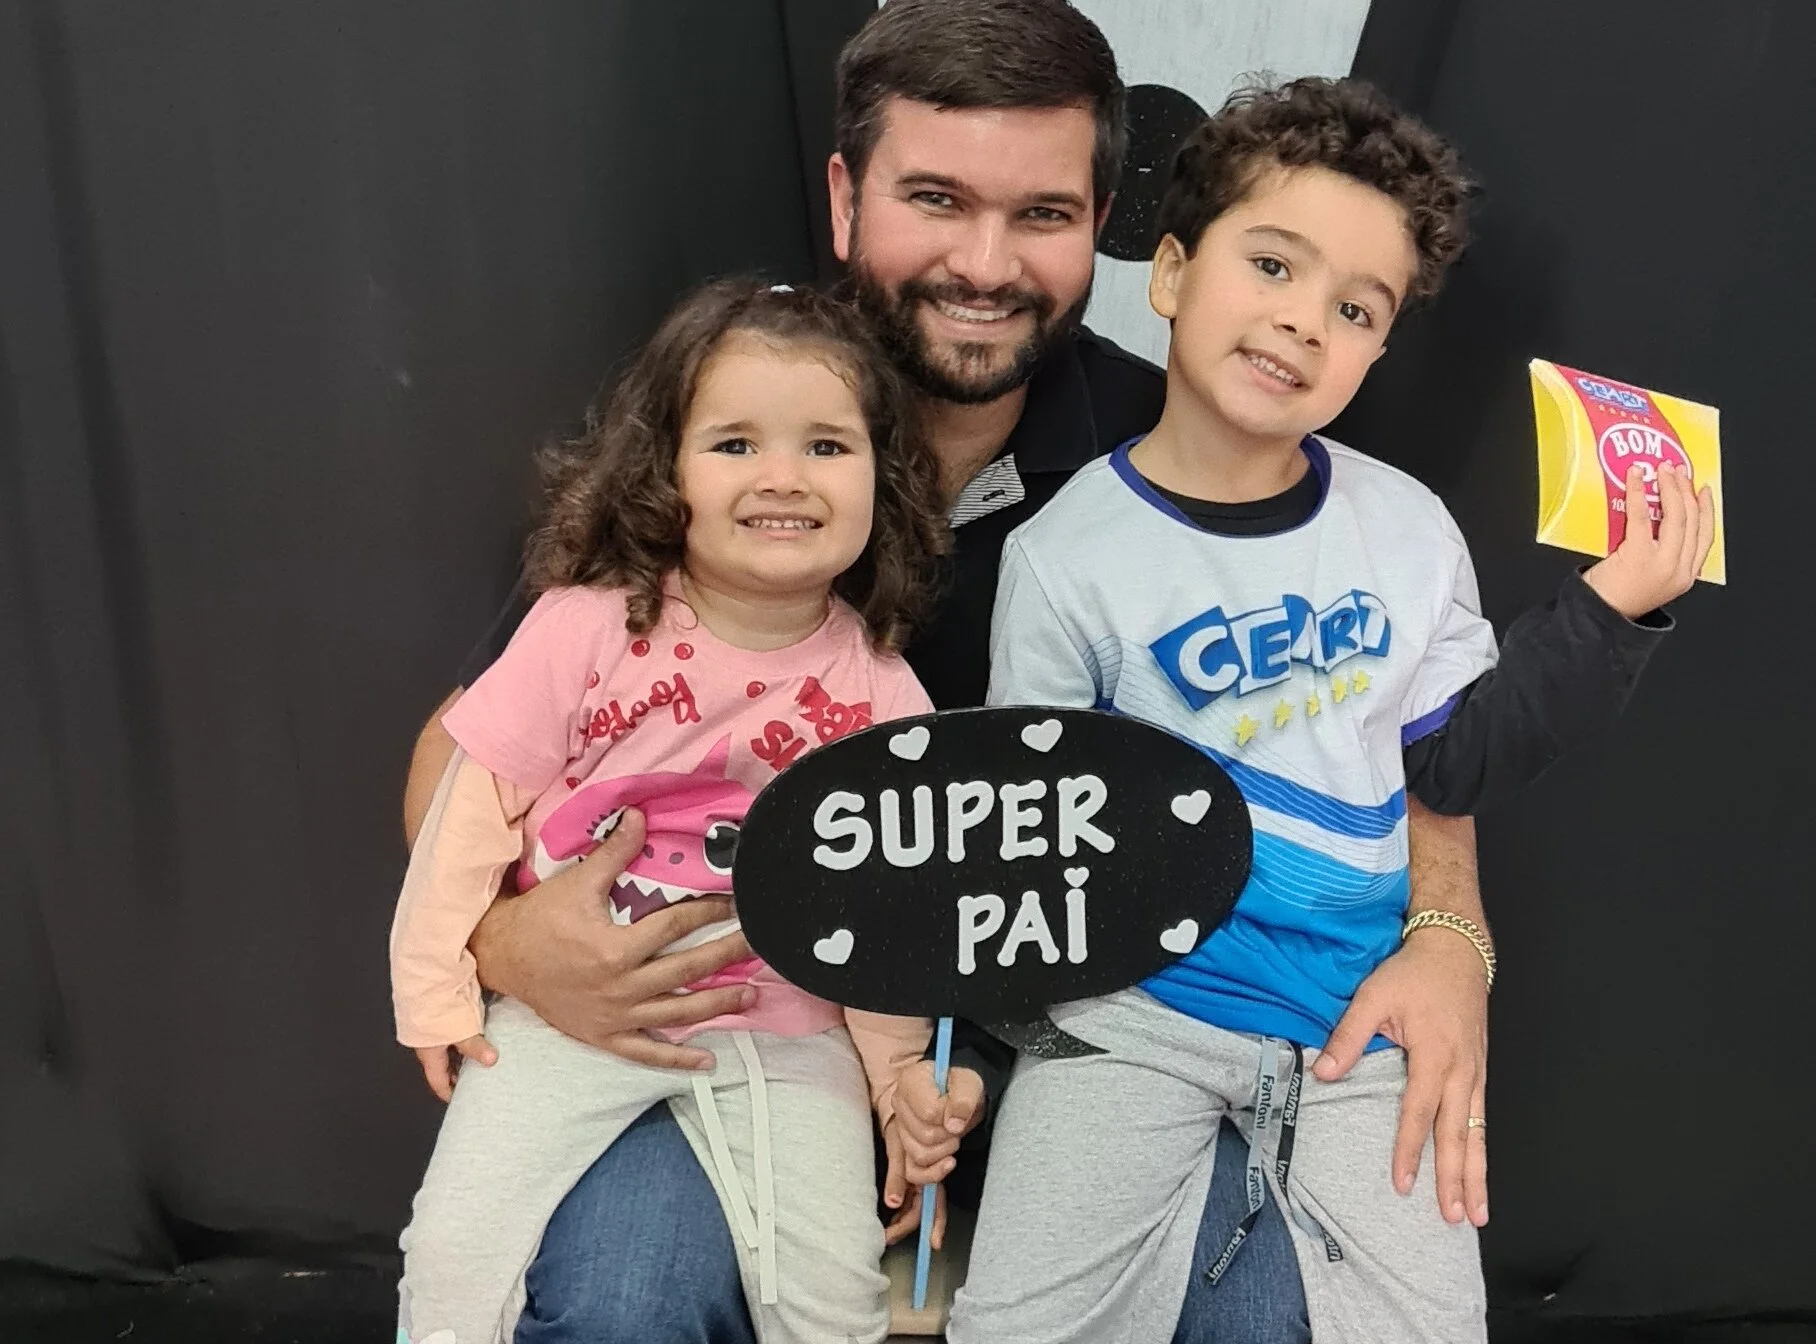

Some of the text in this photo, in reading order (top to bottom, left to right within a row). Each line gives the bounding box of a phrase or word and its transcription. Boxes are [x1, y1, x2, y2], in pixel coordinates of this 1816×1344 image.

[1609, 429, 1664, 459] BOM
[812, 773, 1116, 871] SUPER
[1255, 1073, 1276, 1130] Fantoni
[1248, 1166, 1262, 1210] Fanton
